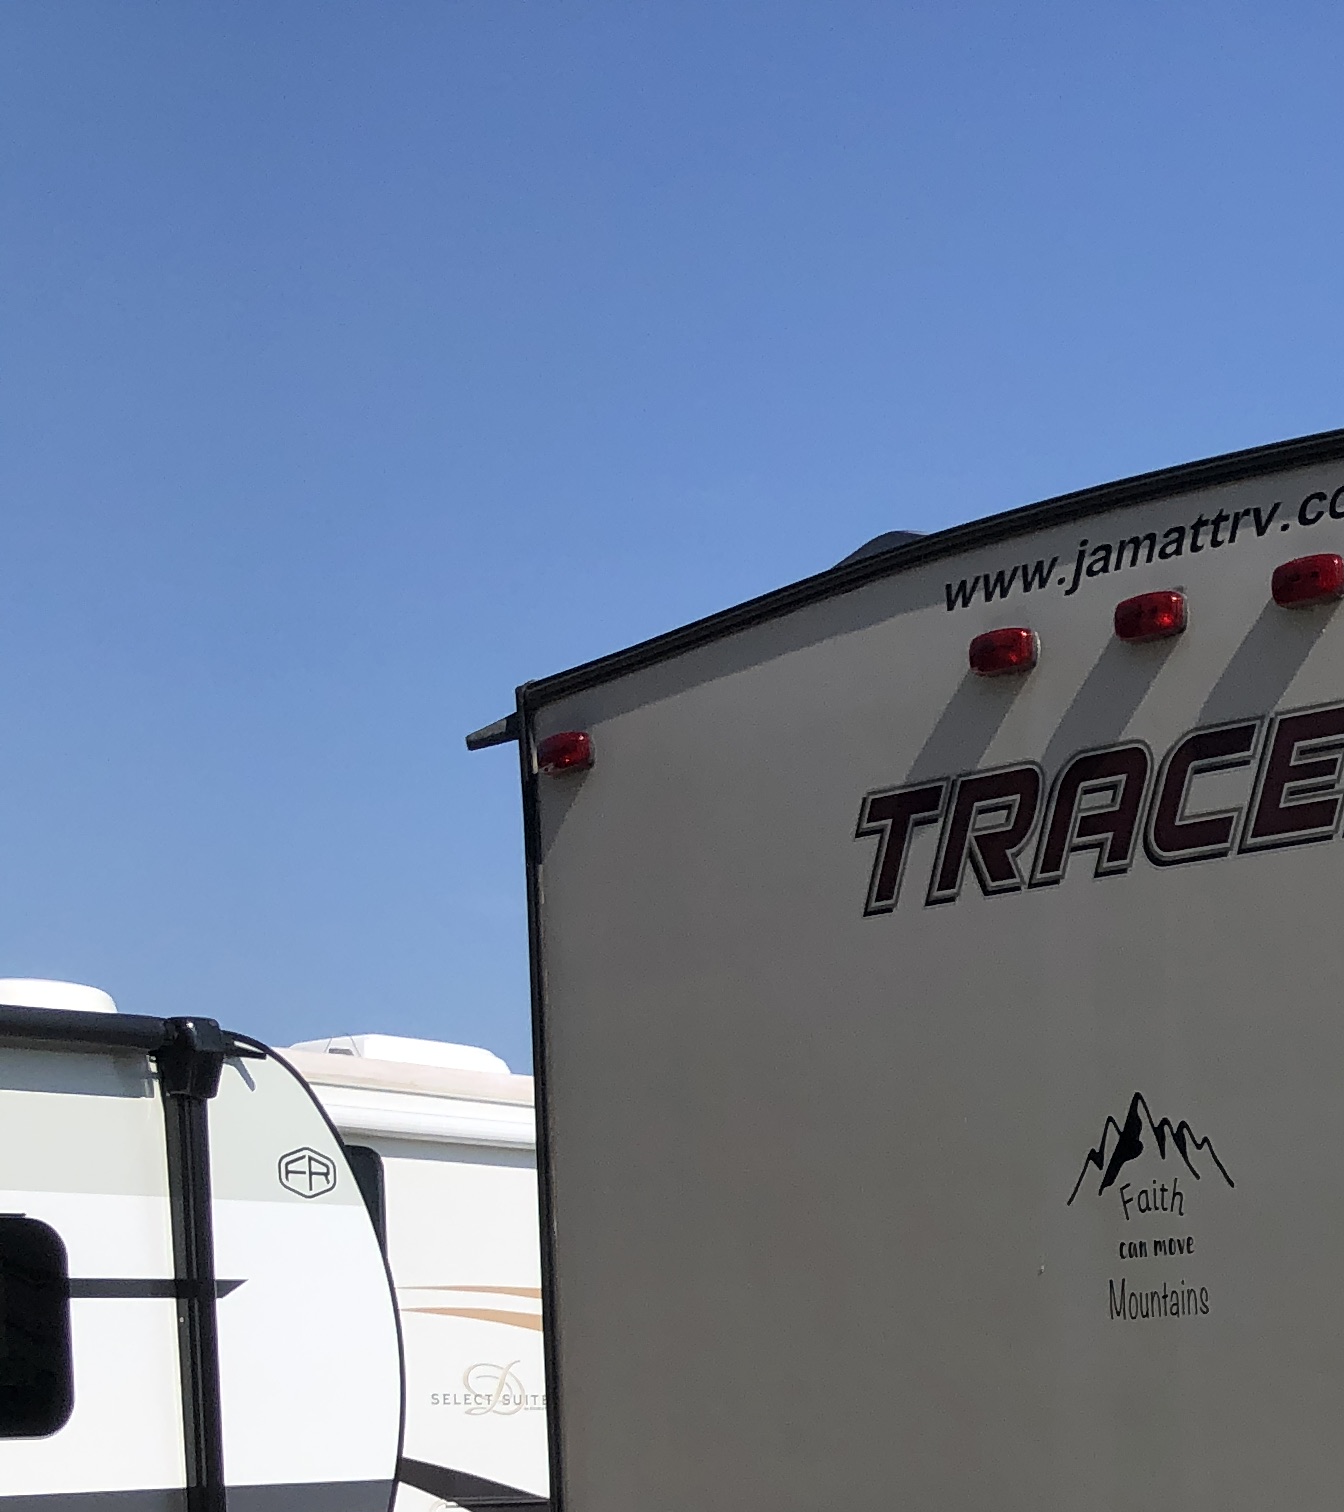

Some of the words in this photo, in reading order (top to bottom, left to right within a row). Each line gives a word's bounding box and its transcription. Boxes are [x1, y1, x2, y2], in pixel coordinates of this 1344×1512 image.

[1119, 1178, 1184, 1221] Faith
[1119, 1240, 1148, 1259] can
[1153, 1236, 1194, 1256] move
[1108, 1277, 1210, 1320] Mountains
[431, 1393, 493, 1405] SELECT
